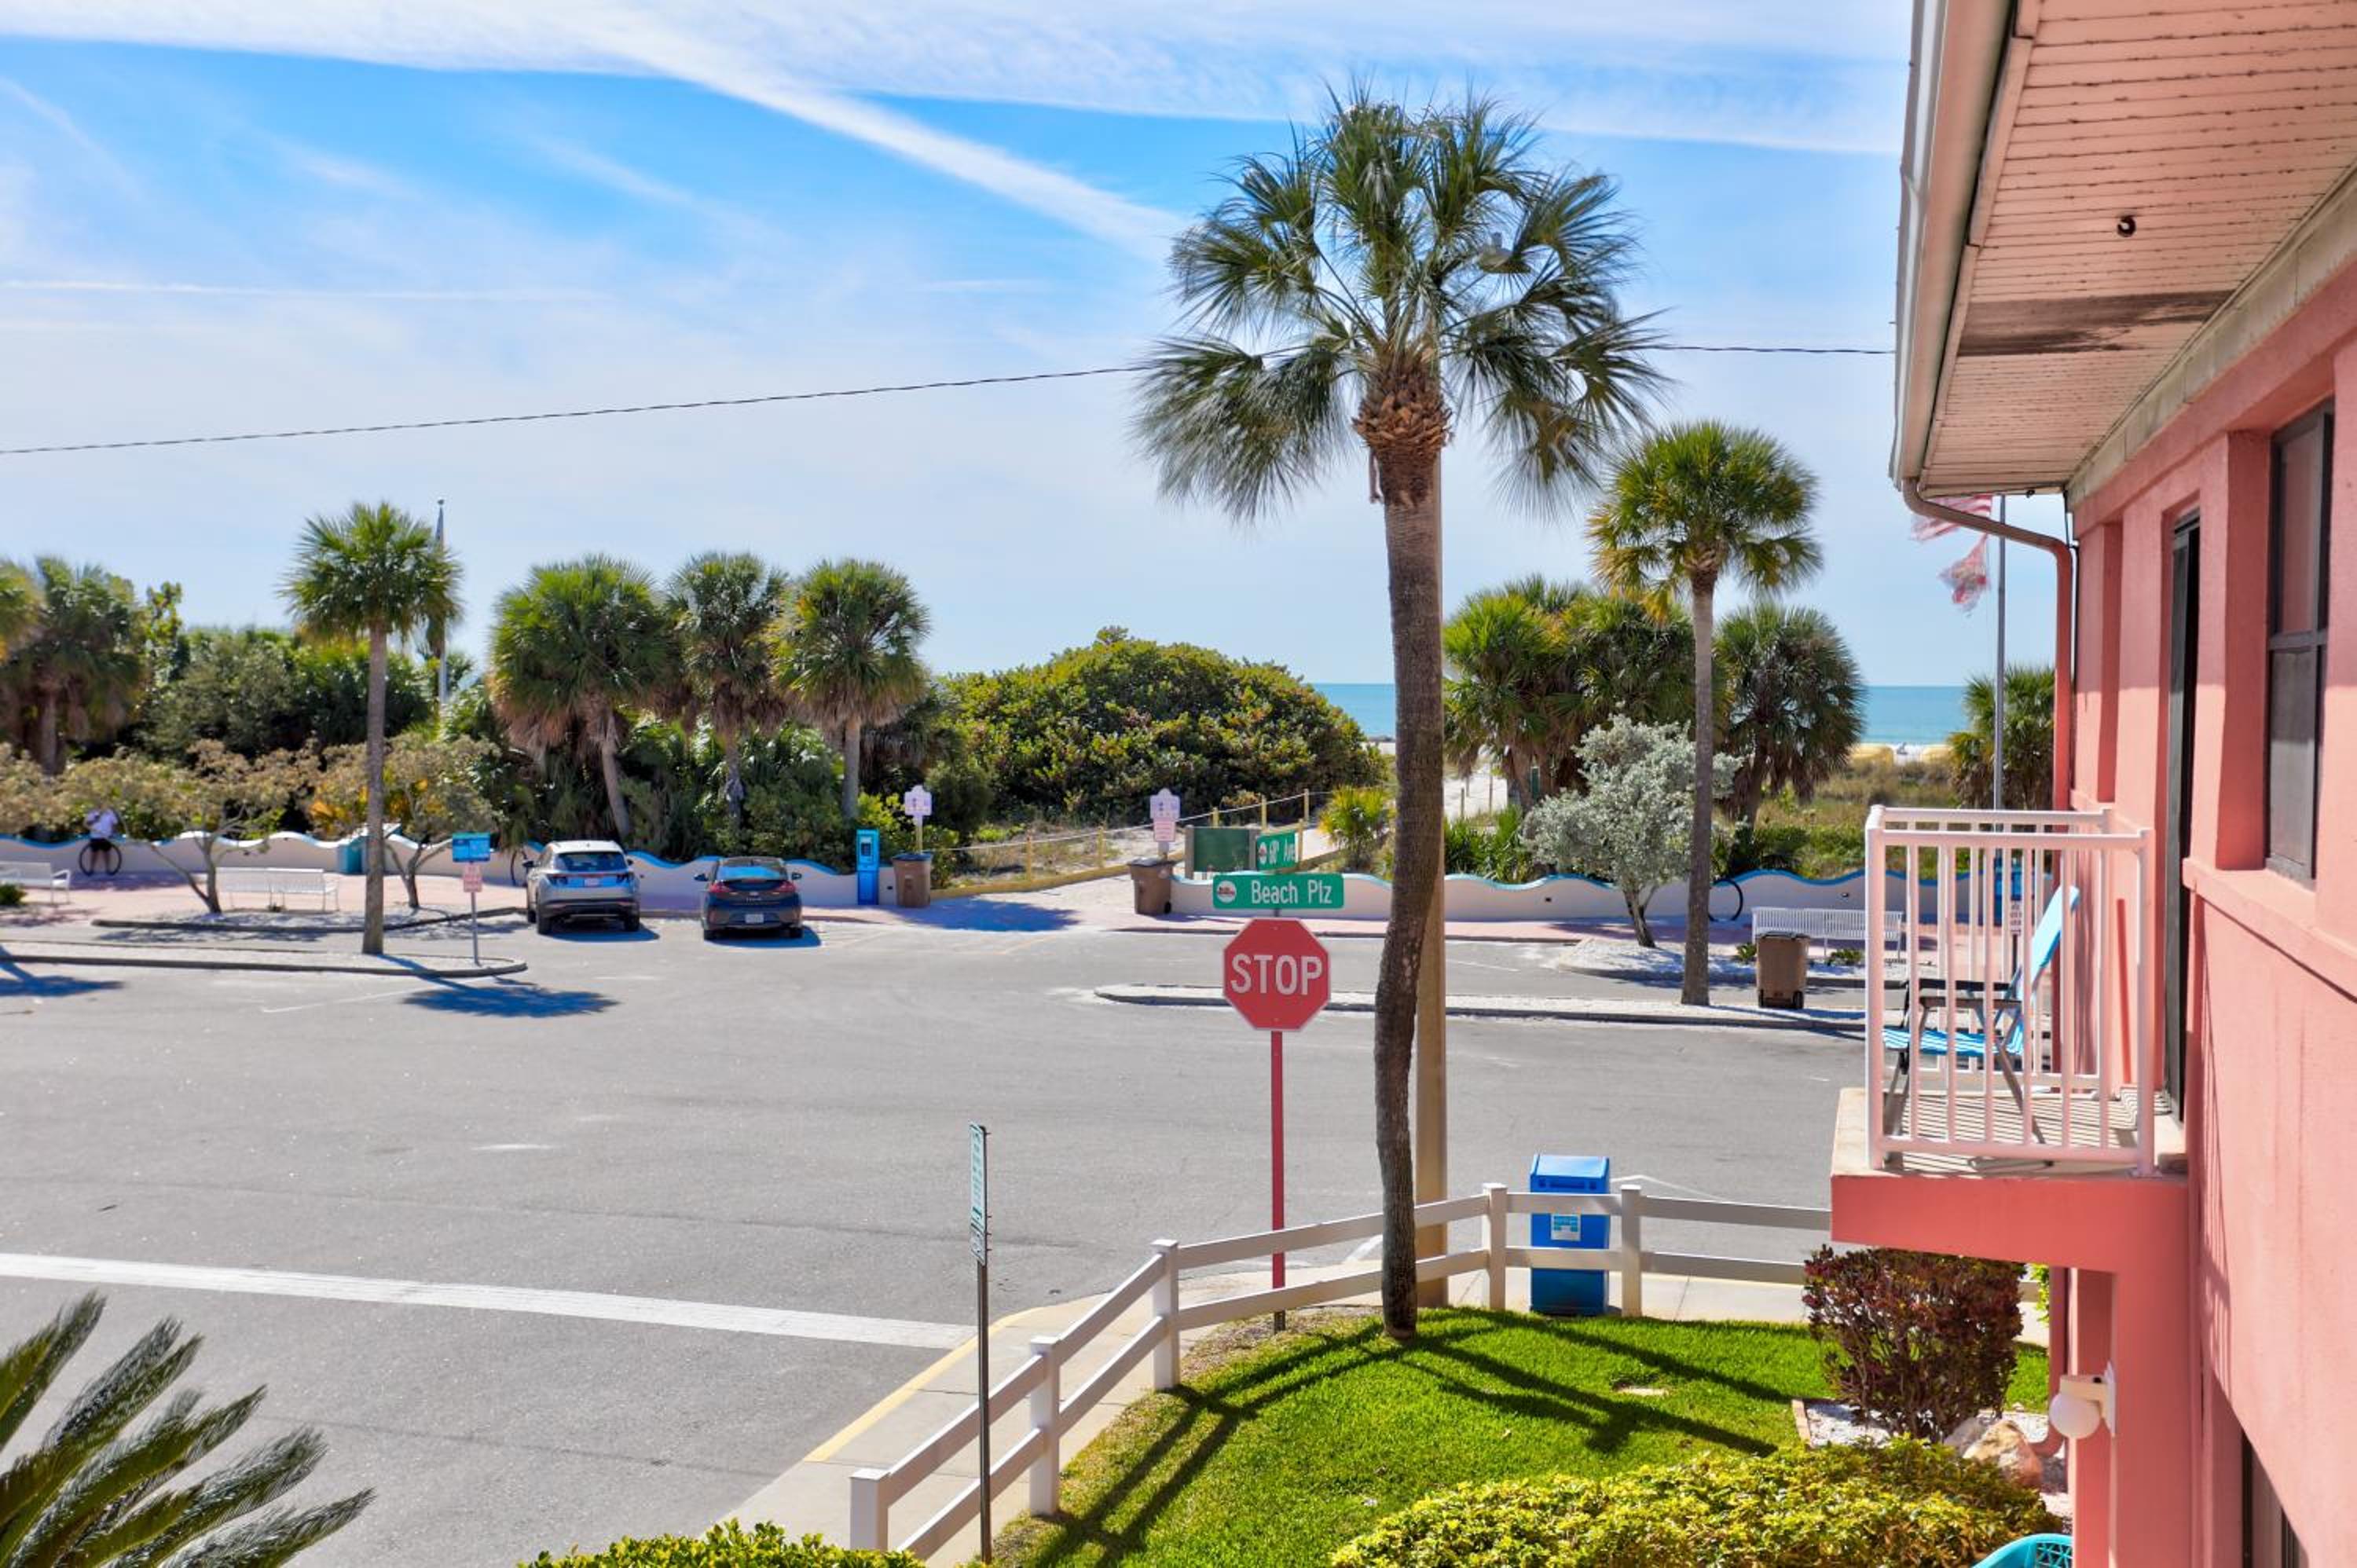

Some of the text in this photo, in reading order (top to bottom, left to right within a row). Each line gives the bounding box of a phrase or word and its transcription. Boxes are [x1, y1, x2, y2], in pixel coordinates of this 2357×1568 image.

[1251, 879, 1298, 904] Beach
[1307, 879, 1332, 904] Plz
[1230, 953, 1322, 995] STOP
